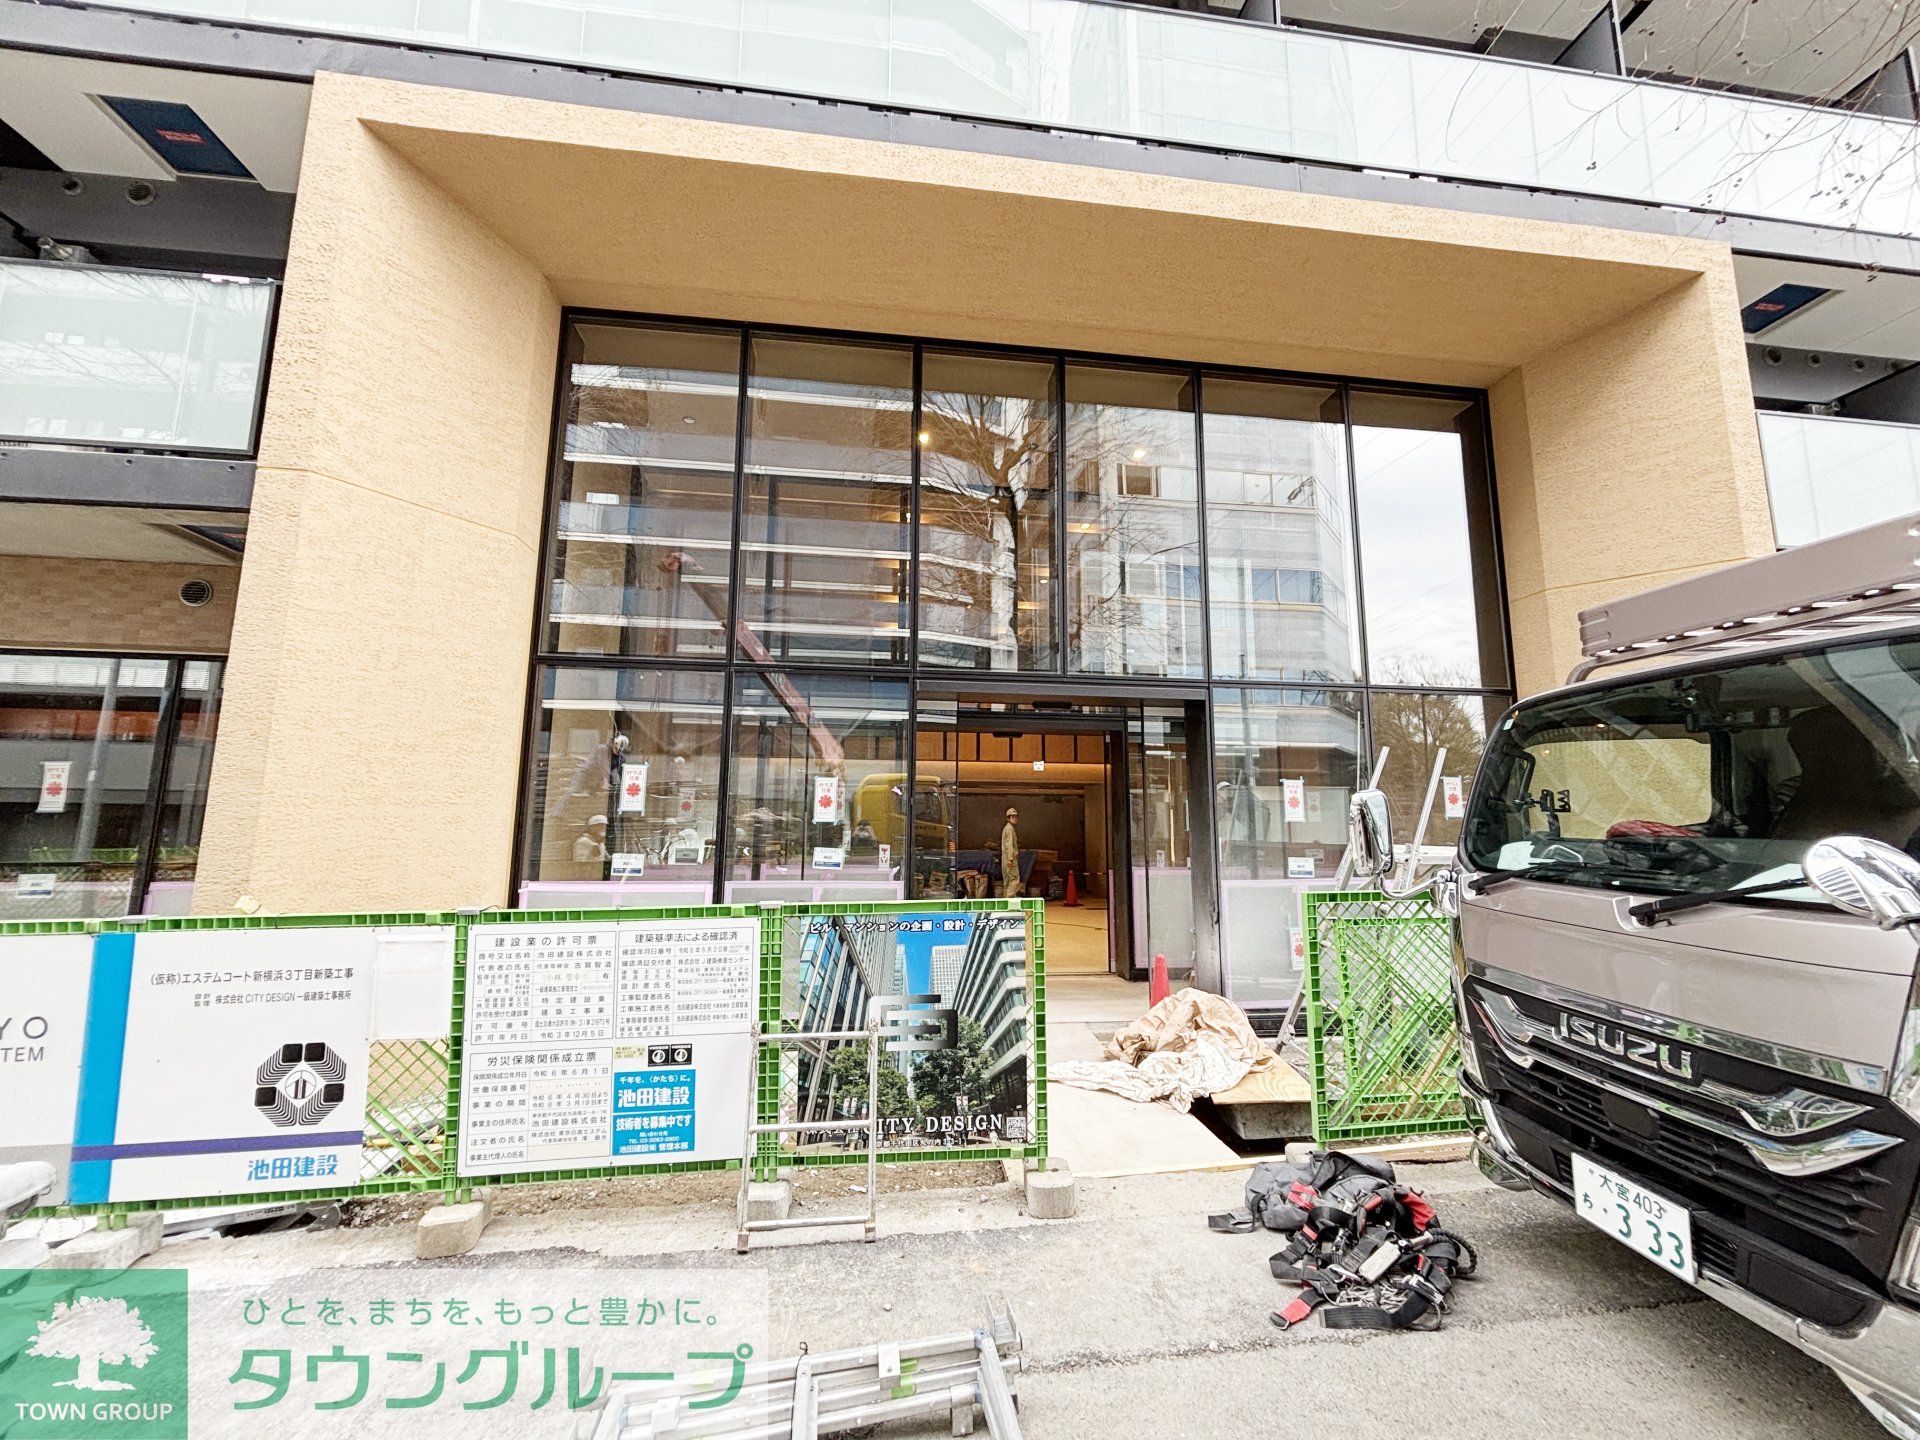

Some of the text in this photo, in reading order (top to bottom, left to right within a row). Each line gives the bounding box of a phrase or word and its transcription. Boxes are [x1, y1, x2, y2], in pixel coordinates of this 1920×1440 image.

[495, 936, 597, 948] 建設業の許可票
[635, 932, 738, 944] 建築基準法による確認済
[538, 950, 612, 958] 池田建設株式会社
[478, 963, 530, 972] 代表者の氏名
[215, 994, 244, 1004] 株式会社
[245, 993, 264, 1004] CITY
[266, 992, 296, 1003] DESIGN
[1558, 1012, 1692, 1078] ISUZU
[487, 1052, 596, 1066] 労災保険関係成立票
[618, 1086, 690, 1108] 池田建設
[926, 1114, 1003, 1133] DESIGN
[247, 1155, 338, 1182] 池田建設
[1582, 1192, 1593, 1208] ち
